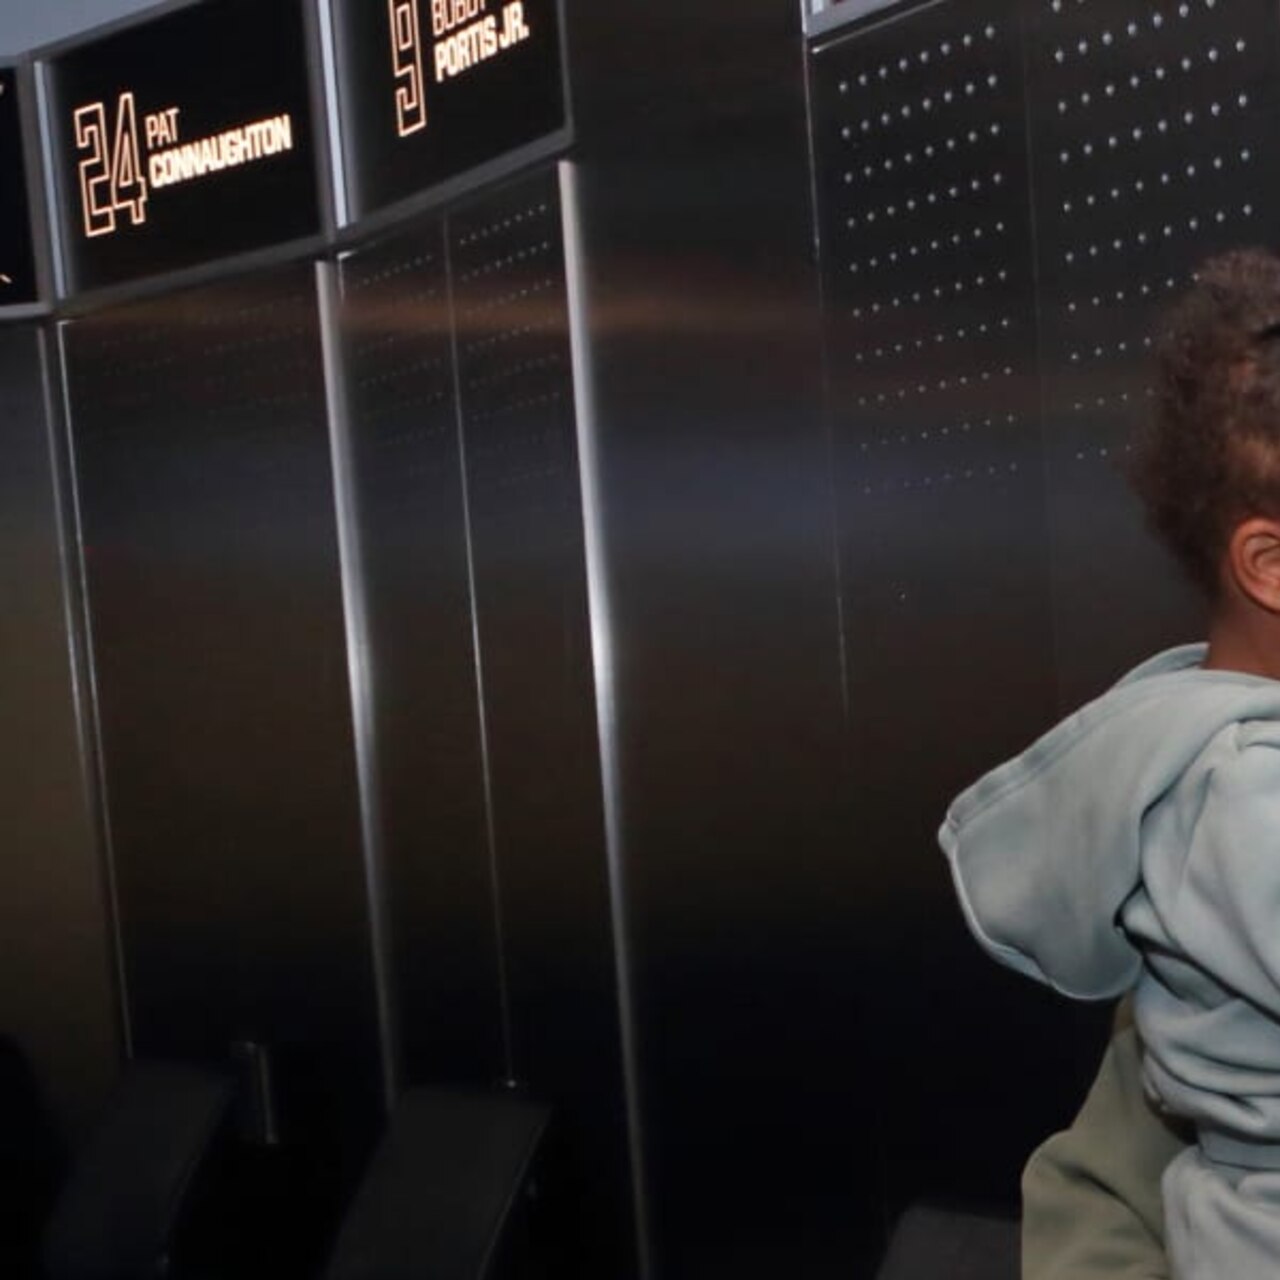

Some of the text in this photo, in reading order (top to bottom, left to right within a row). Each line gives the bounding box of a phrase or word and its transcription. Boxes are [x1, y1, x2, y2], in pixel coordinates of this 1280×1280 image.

[431, 0, 486, 36] BOB
[434, 0, 530, 82] PORTIS JR.
[388, 0, 427, 137] 9
[74, 92, 147, 237] 24
[145, 106, 180, 149] PAT
[149, 114, 292, 188] CONNAUGHTON
